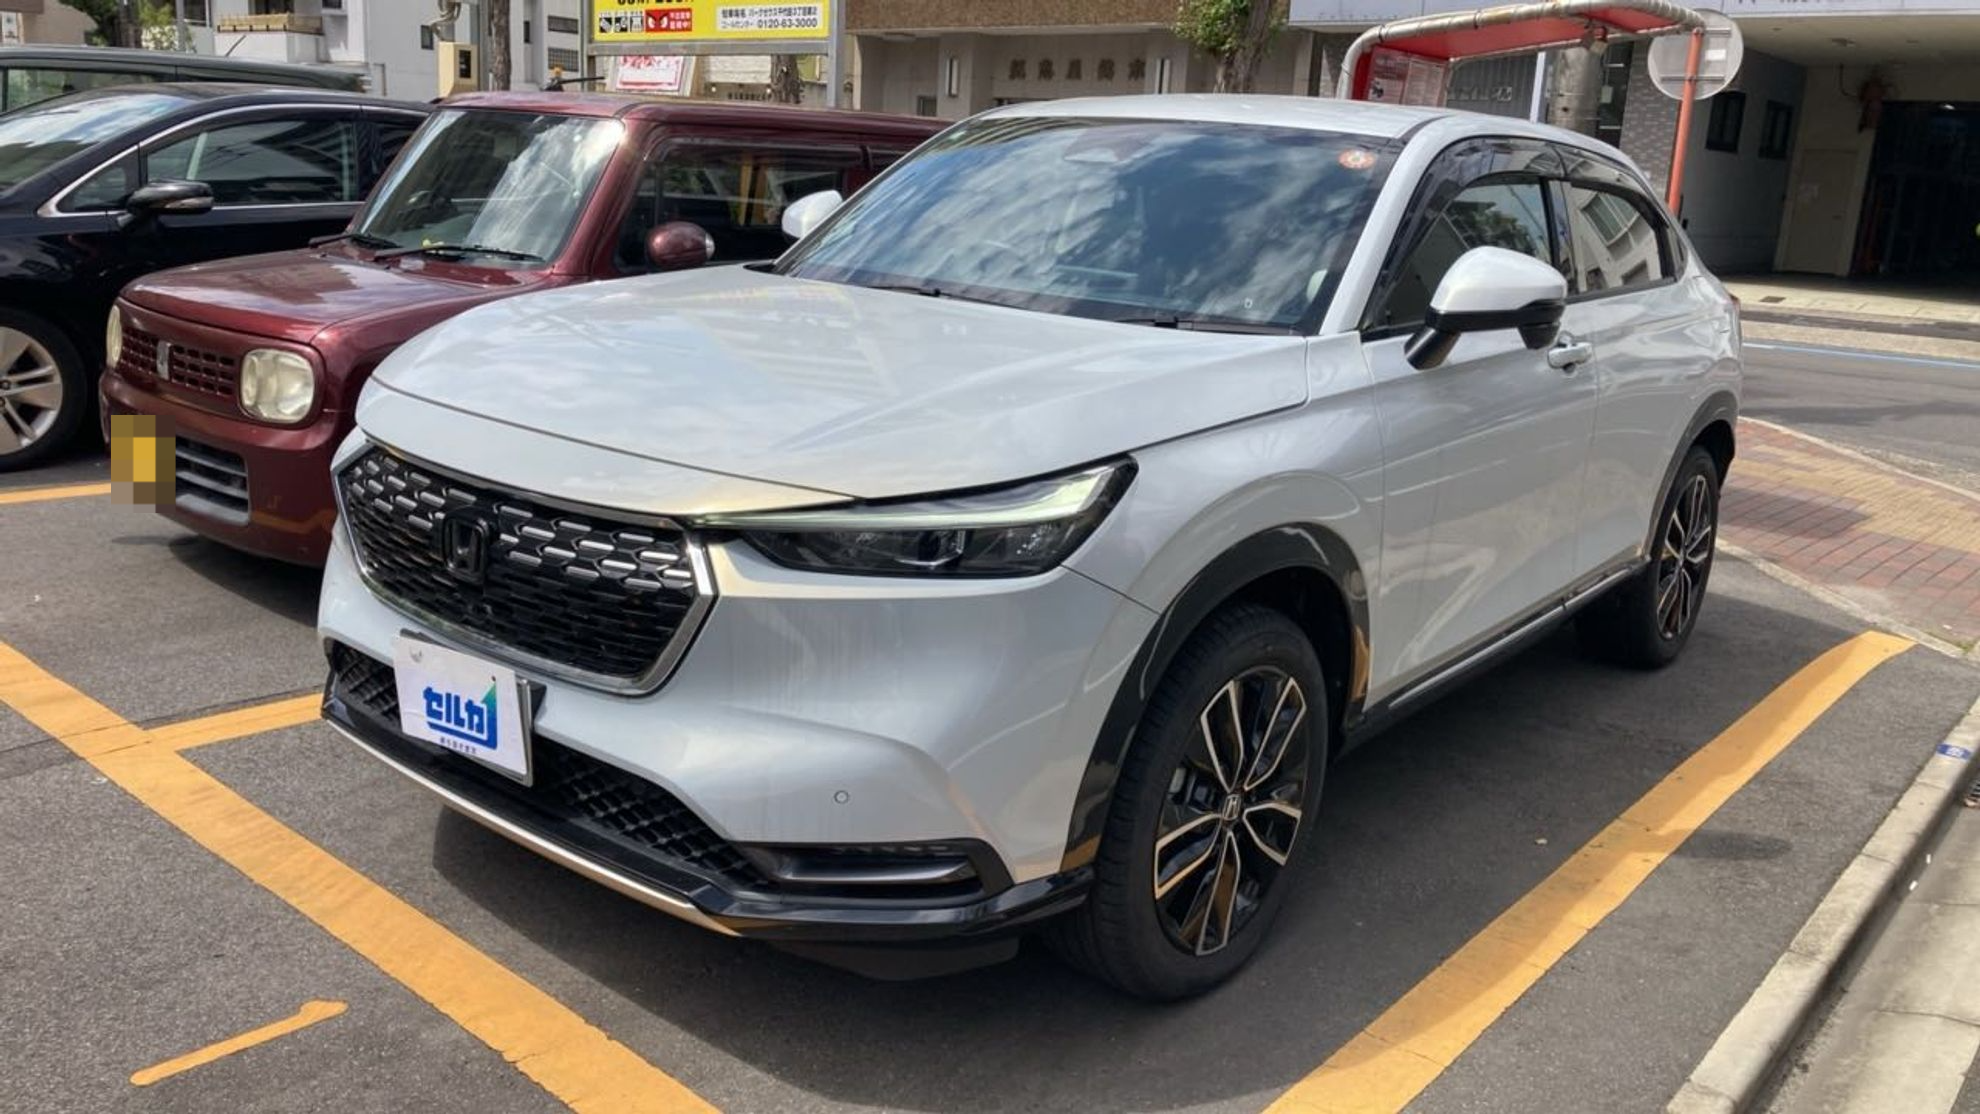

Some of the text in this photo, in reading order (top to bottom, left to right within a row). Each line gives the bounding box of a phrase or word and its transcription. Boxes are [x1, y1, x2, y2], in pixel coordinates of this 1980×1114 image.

[757, 17, 818, 29] 0120-63-3000
[423, 686, 486, 735] セルカ
